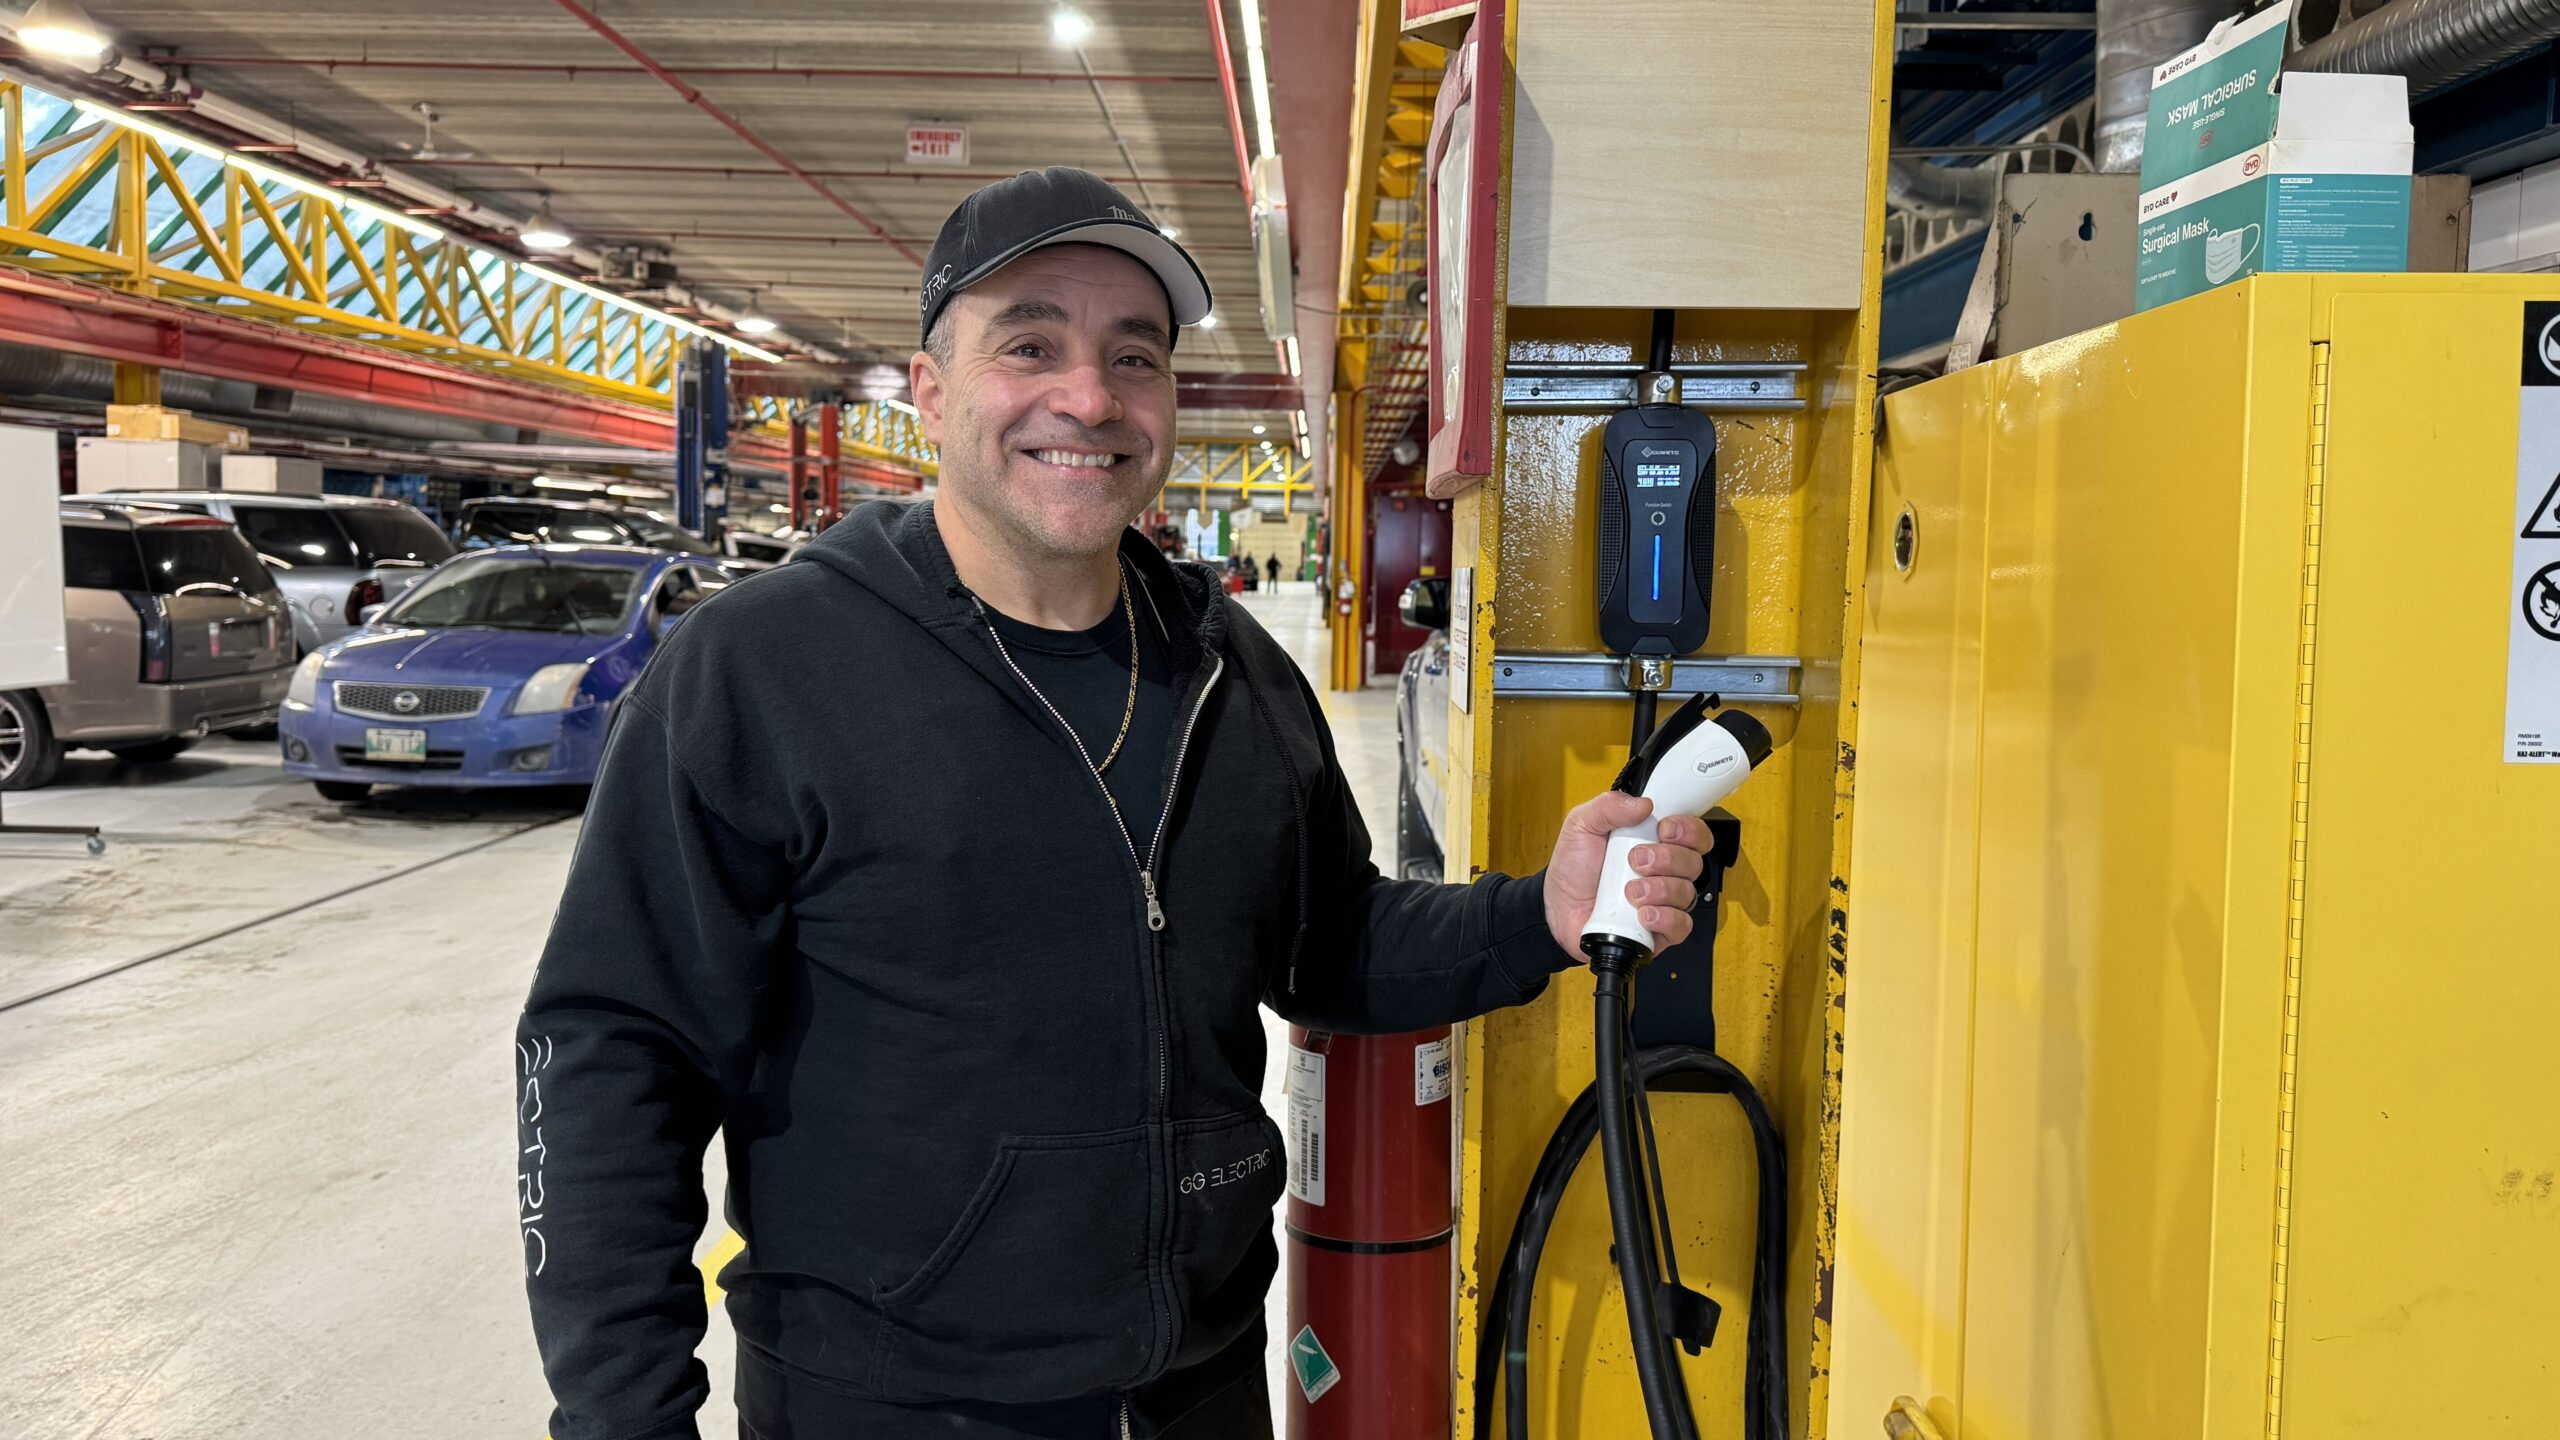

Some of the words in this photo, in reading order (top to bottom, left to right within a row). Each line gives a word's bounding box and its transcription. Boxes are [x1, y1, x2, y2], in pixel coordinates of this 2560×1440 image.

[2168, 61, 2184, 76] CARE
[2201, 69, 2257, 110] SURGICAL
[2167, 98, 2199, 127] MASK
[2192, 107, 2225, 130] SINGLE-USE
[2143, 203, 2154, 214] BYD
[2155, 196, 2170, 209] CARE
[2142, 226, 2180, 255] Surgical
[2181, 216, 2210, 241] Mask
[1180, 1172, 1206, 1194] GG
[1211, 1148, 1270, 1187] ELECTRIC
